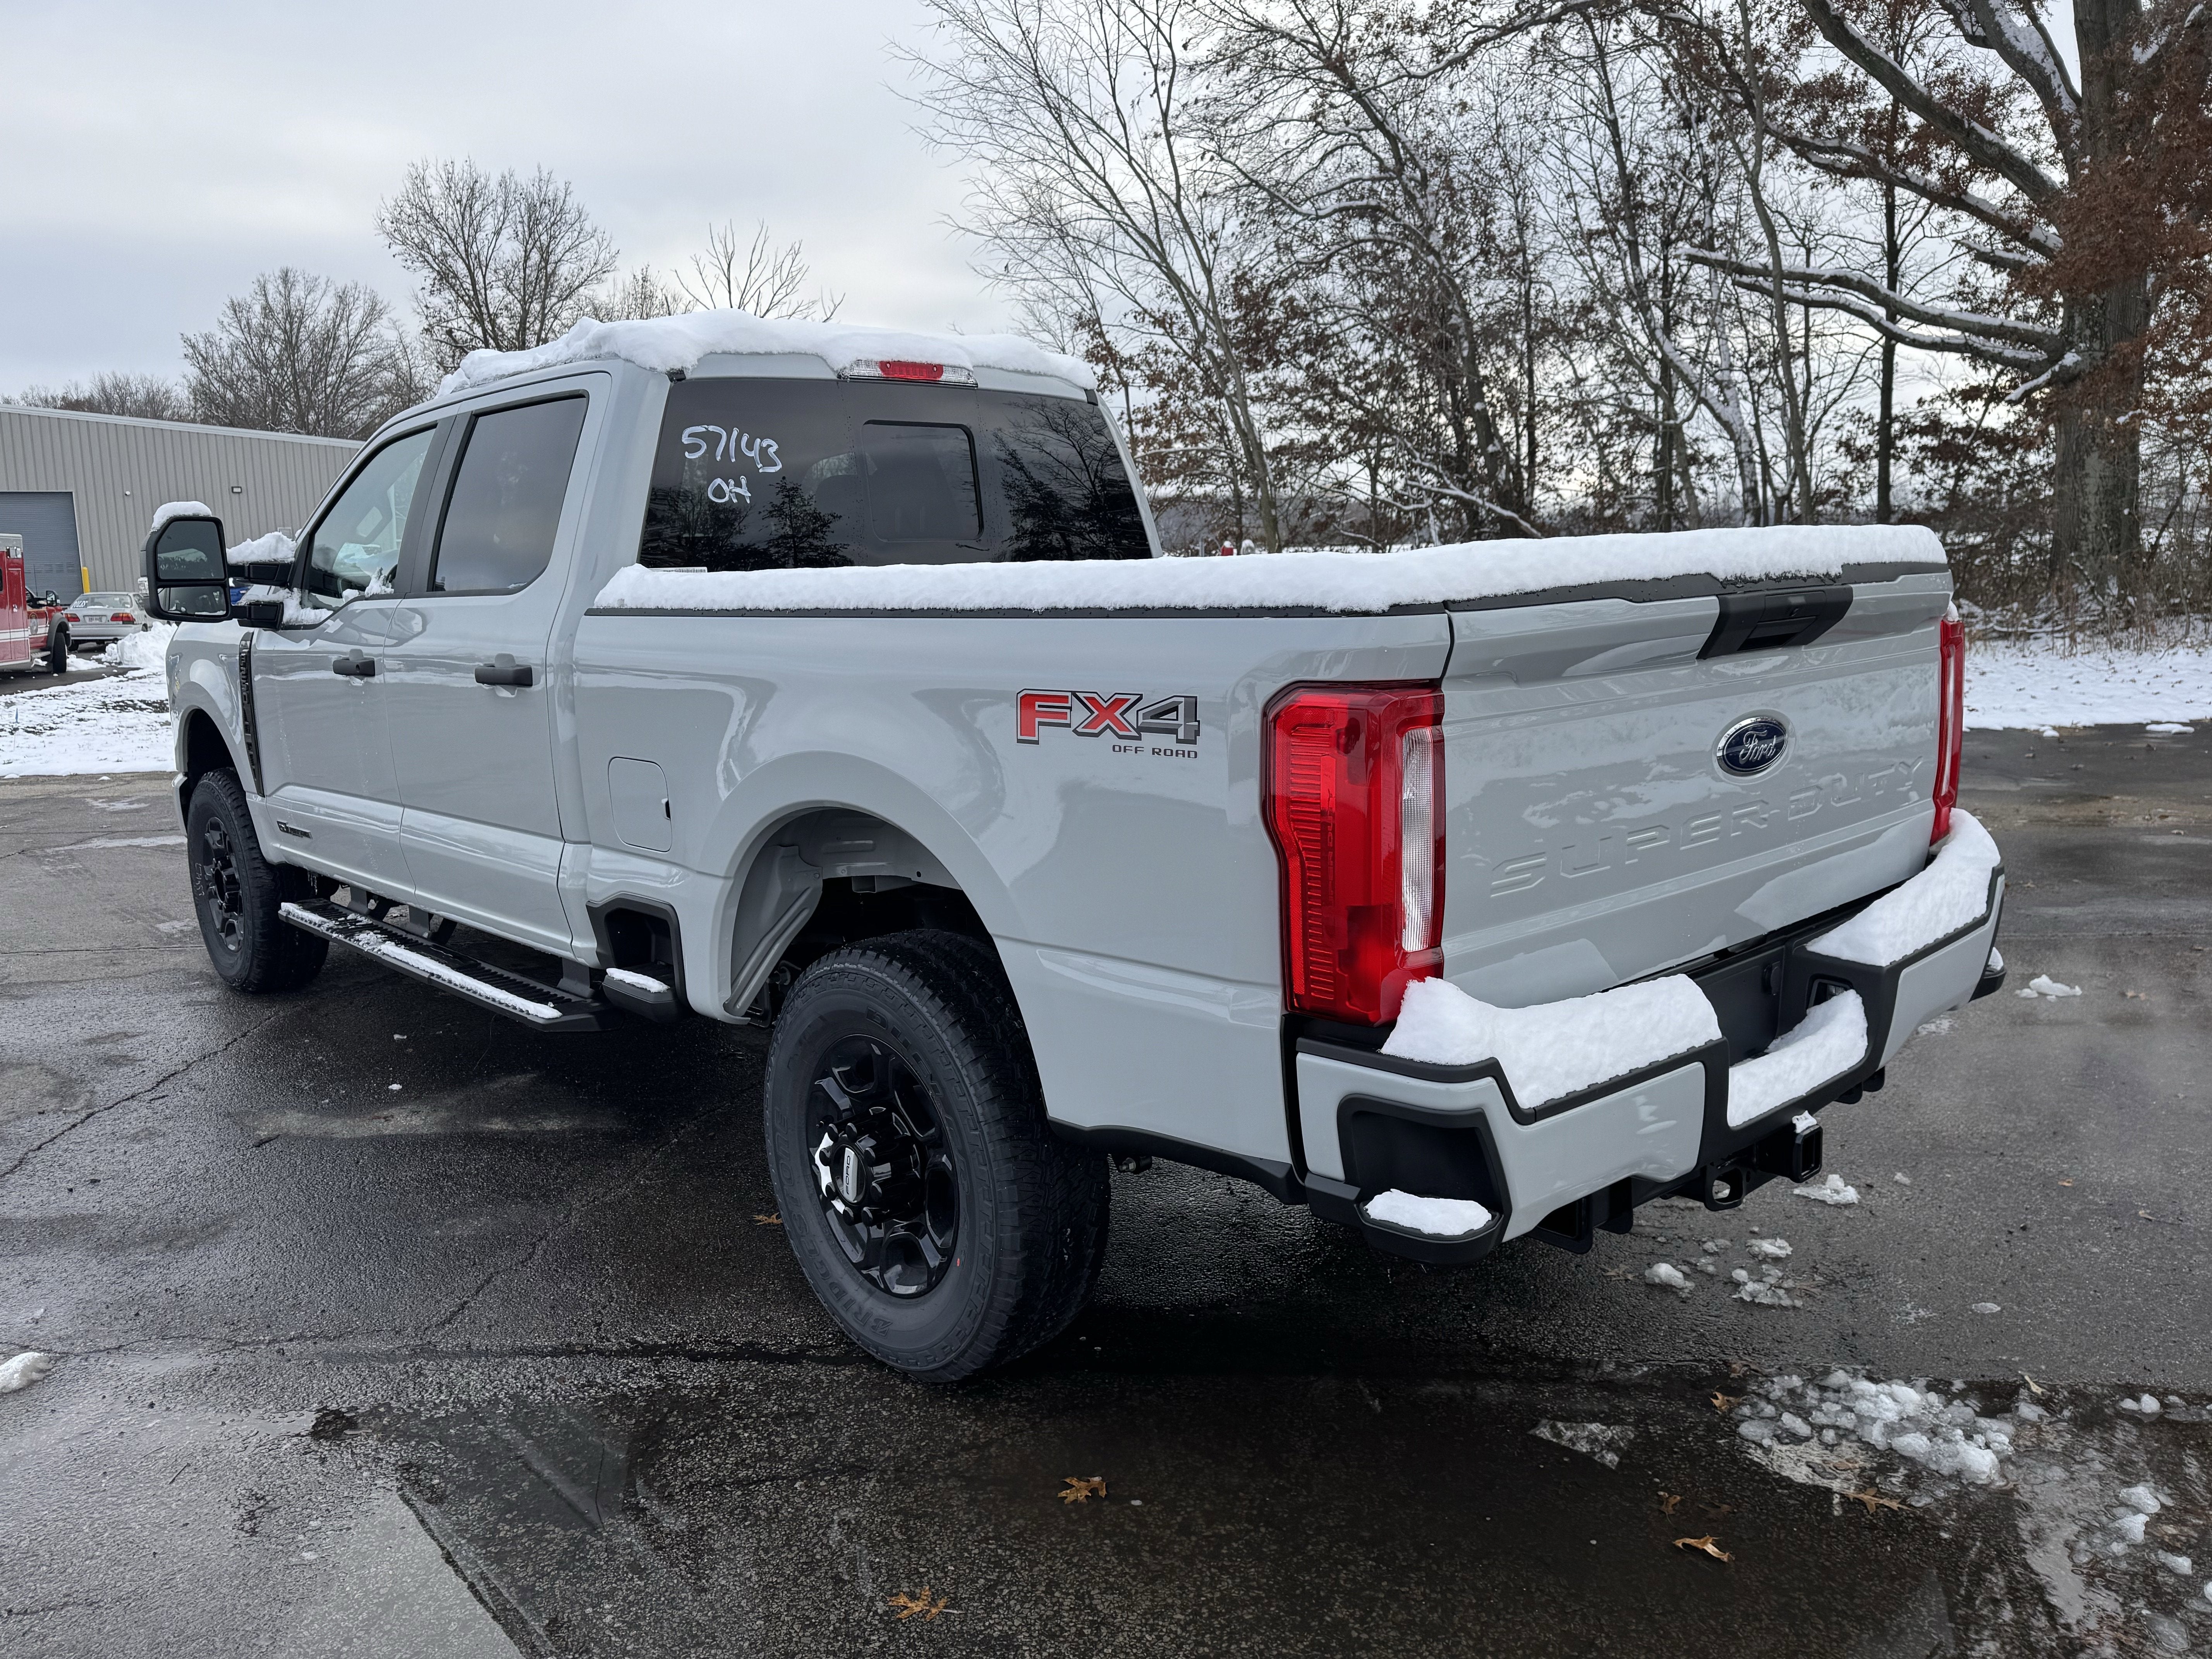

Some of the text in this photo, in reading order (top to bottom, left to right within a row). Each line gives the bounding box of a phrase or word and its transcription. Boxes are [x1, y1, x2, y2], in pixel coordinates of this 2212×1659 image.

[682, 425, 782, 473] 57143
[708, 475, 752, 503] OH
[1016, 688, 1200, 745] FX4
[1112, 744, 1198, 759] OFF ROAD
[1739, 730, 1776, 764] Ford
[1490, 756, 1923, 898] SUPER DUTY
